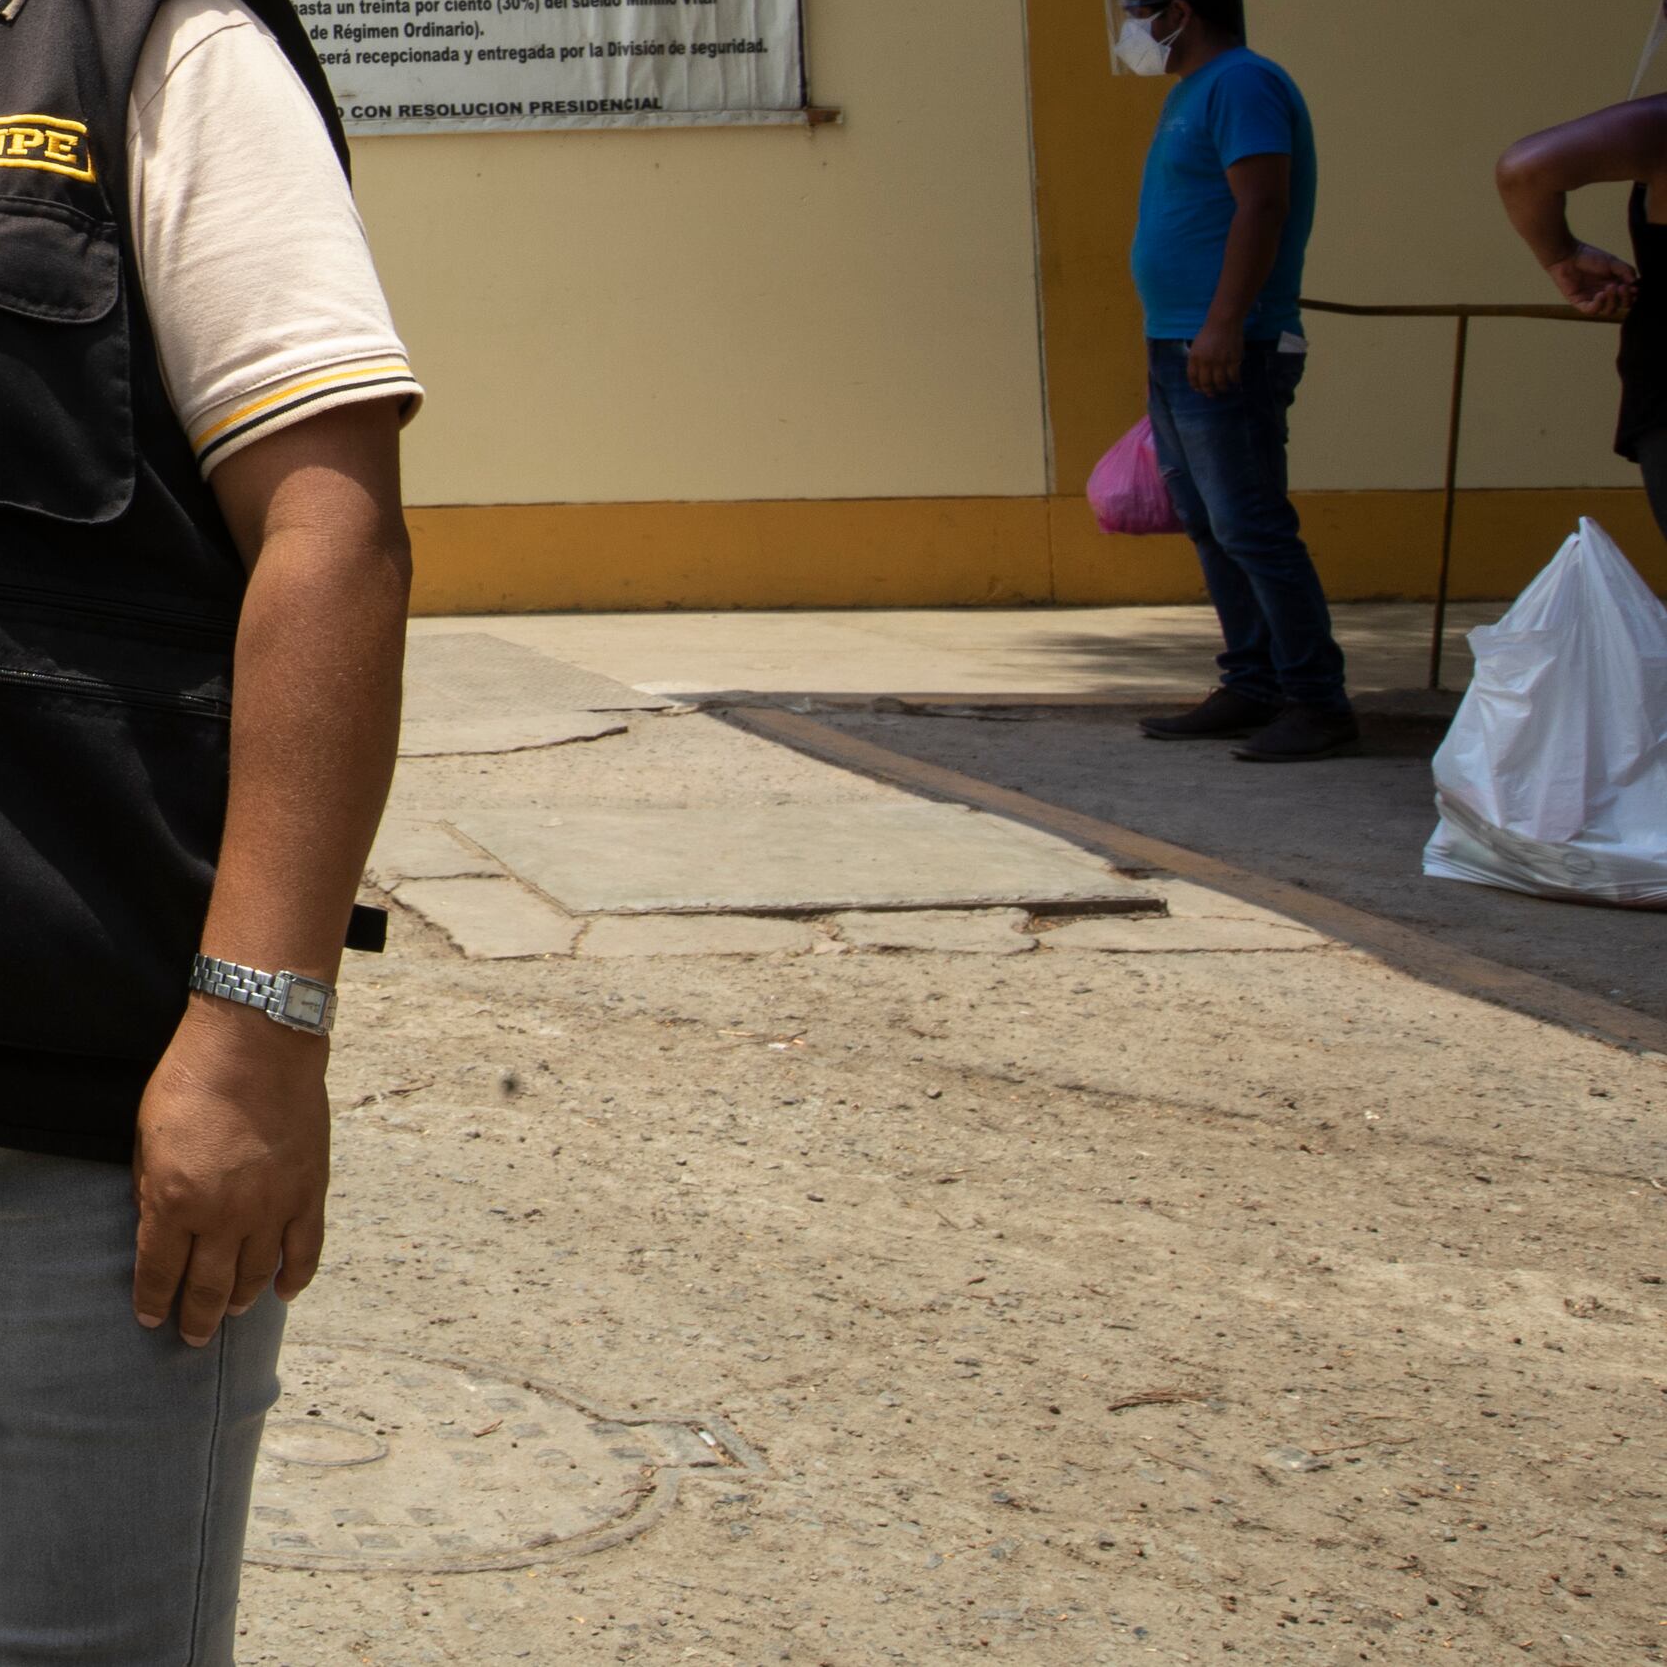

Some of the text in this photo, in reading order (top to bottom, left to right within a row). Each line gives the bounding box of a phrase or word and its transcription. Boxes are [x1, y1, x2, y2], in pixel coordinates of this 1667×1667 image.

[351, 96, 666, 119] CON RESOLUCION PRESIDENCIAL
